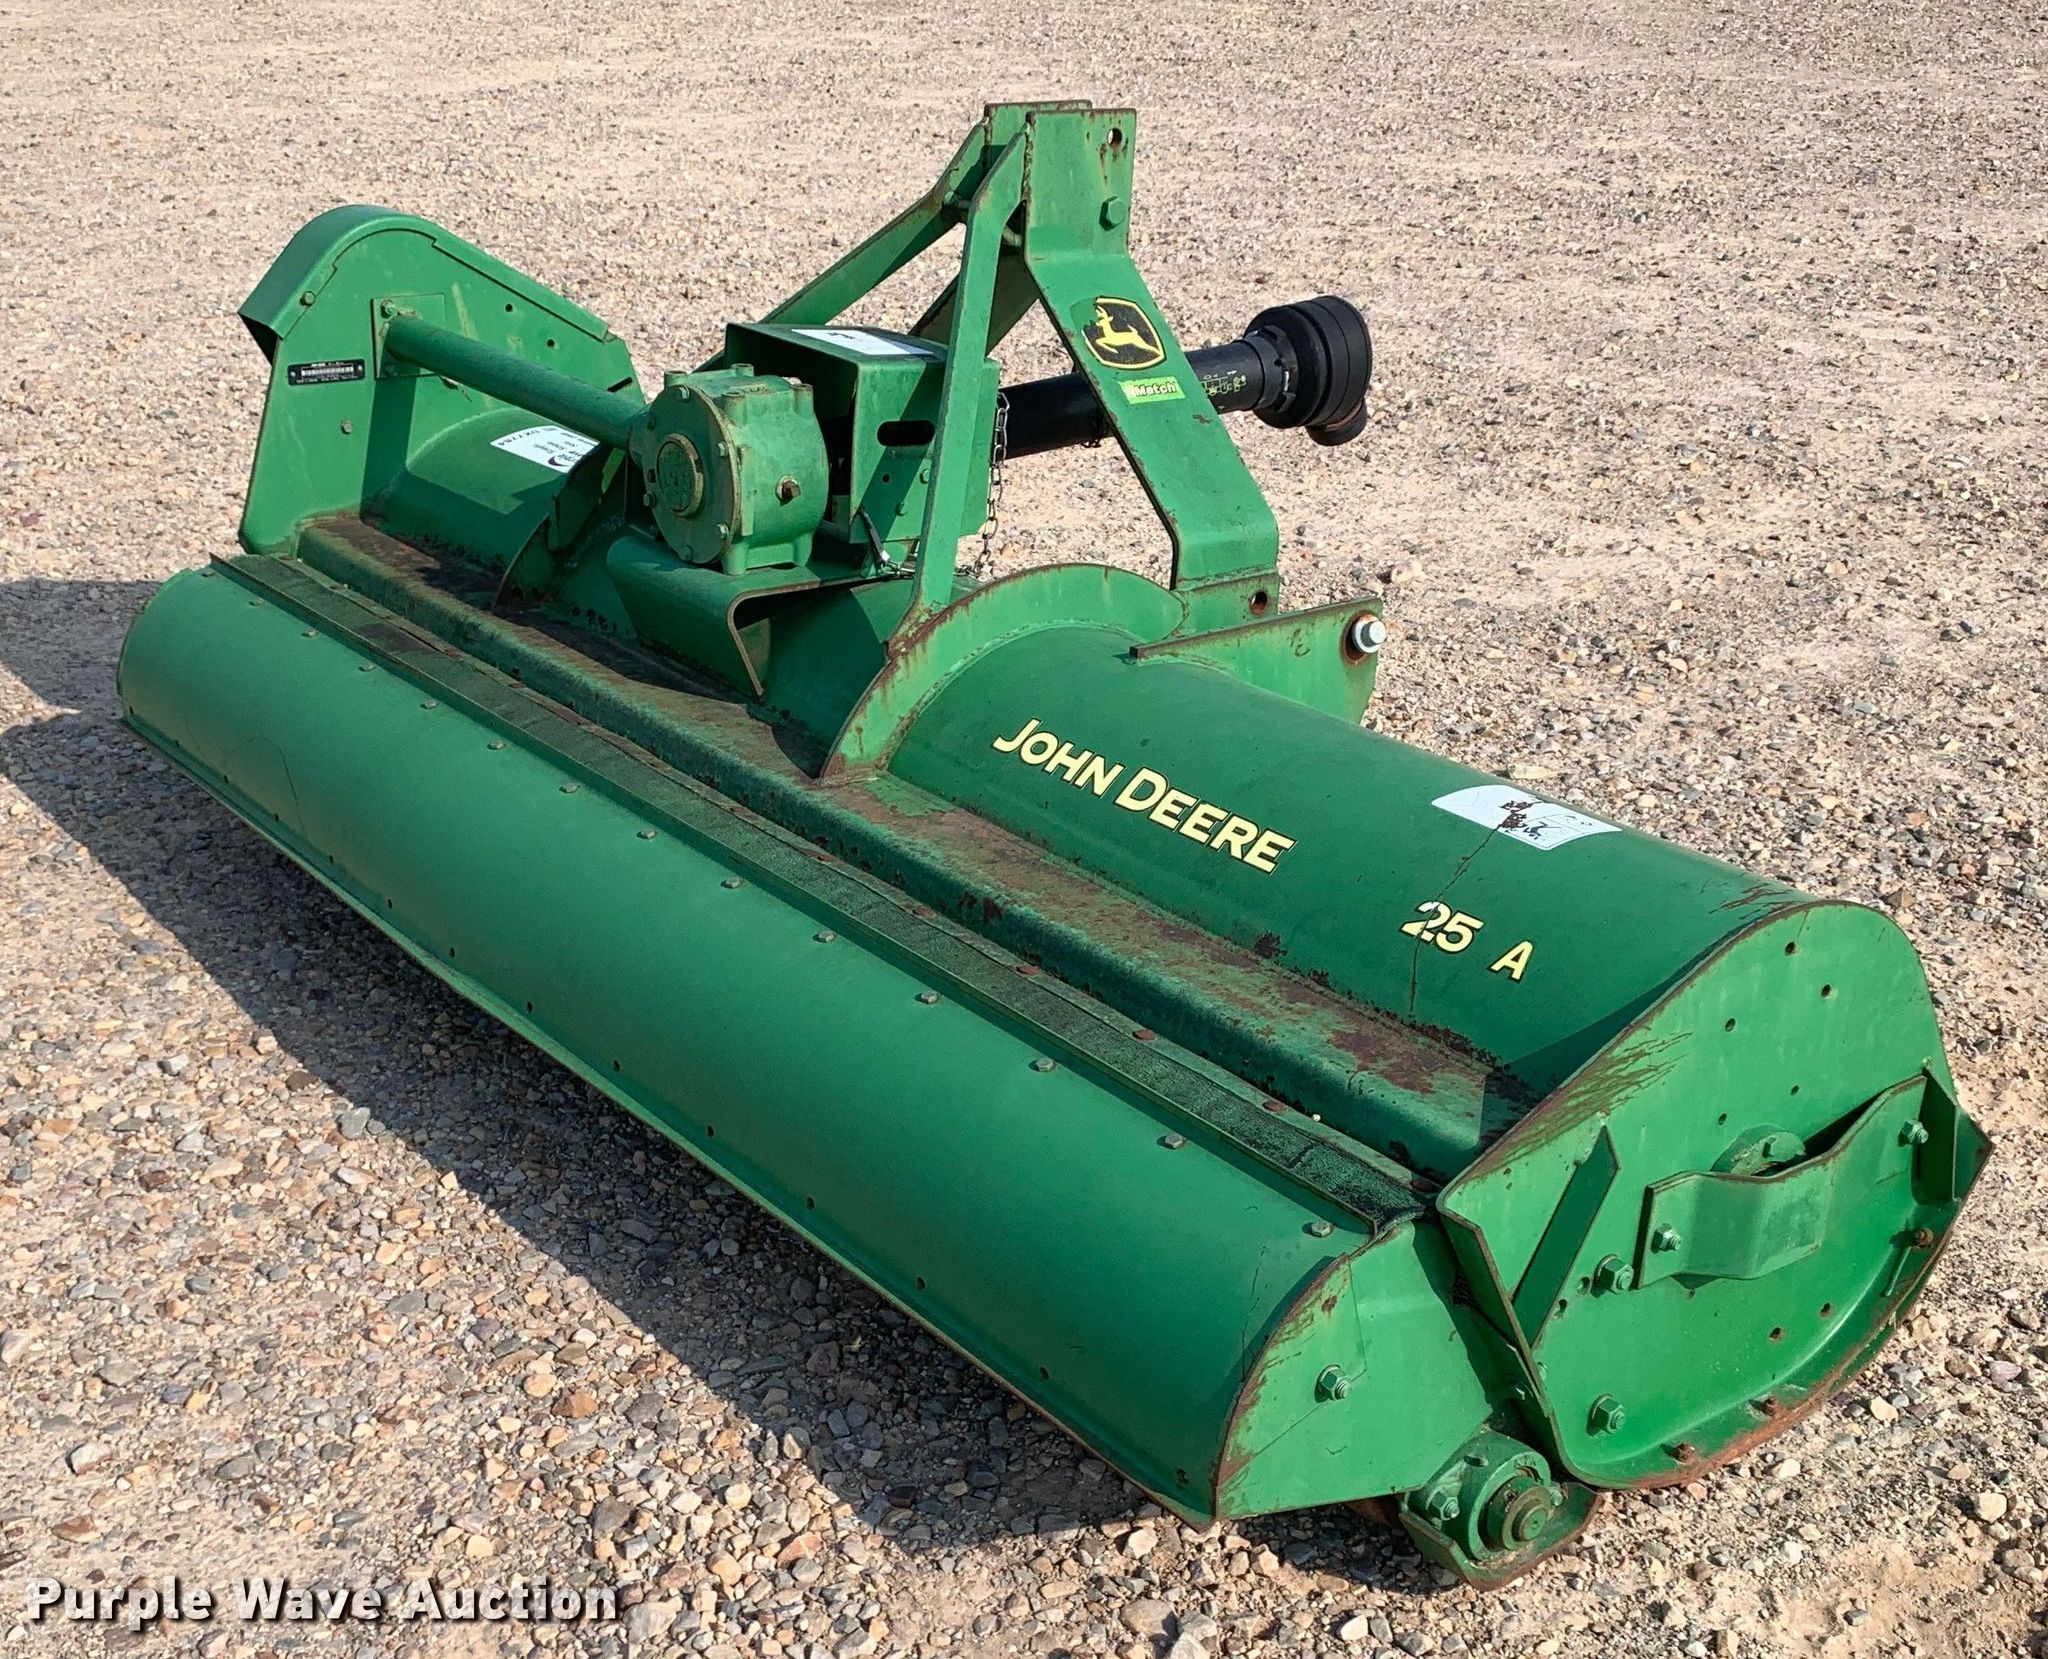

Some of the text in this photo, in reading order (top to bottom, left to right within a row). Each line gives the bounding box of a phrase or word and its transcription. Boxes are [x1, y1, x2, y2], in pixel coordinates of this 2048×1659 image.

[992, 717, 1298, 874] JOHN DEERE
[1401, 900, 1534, 983] 25 A
